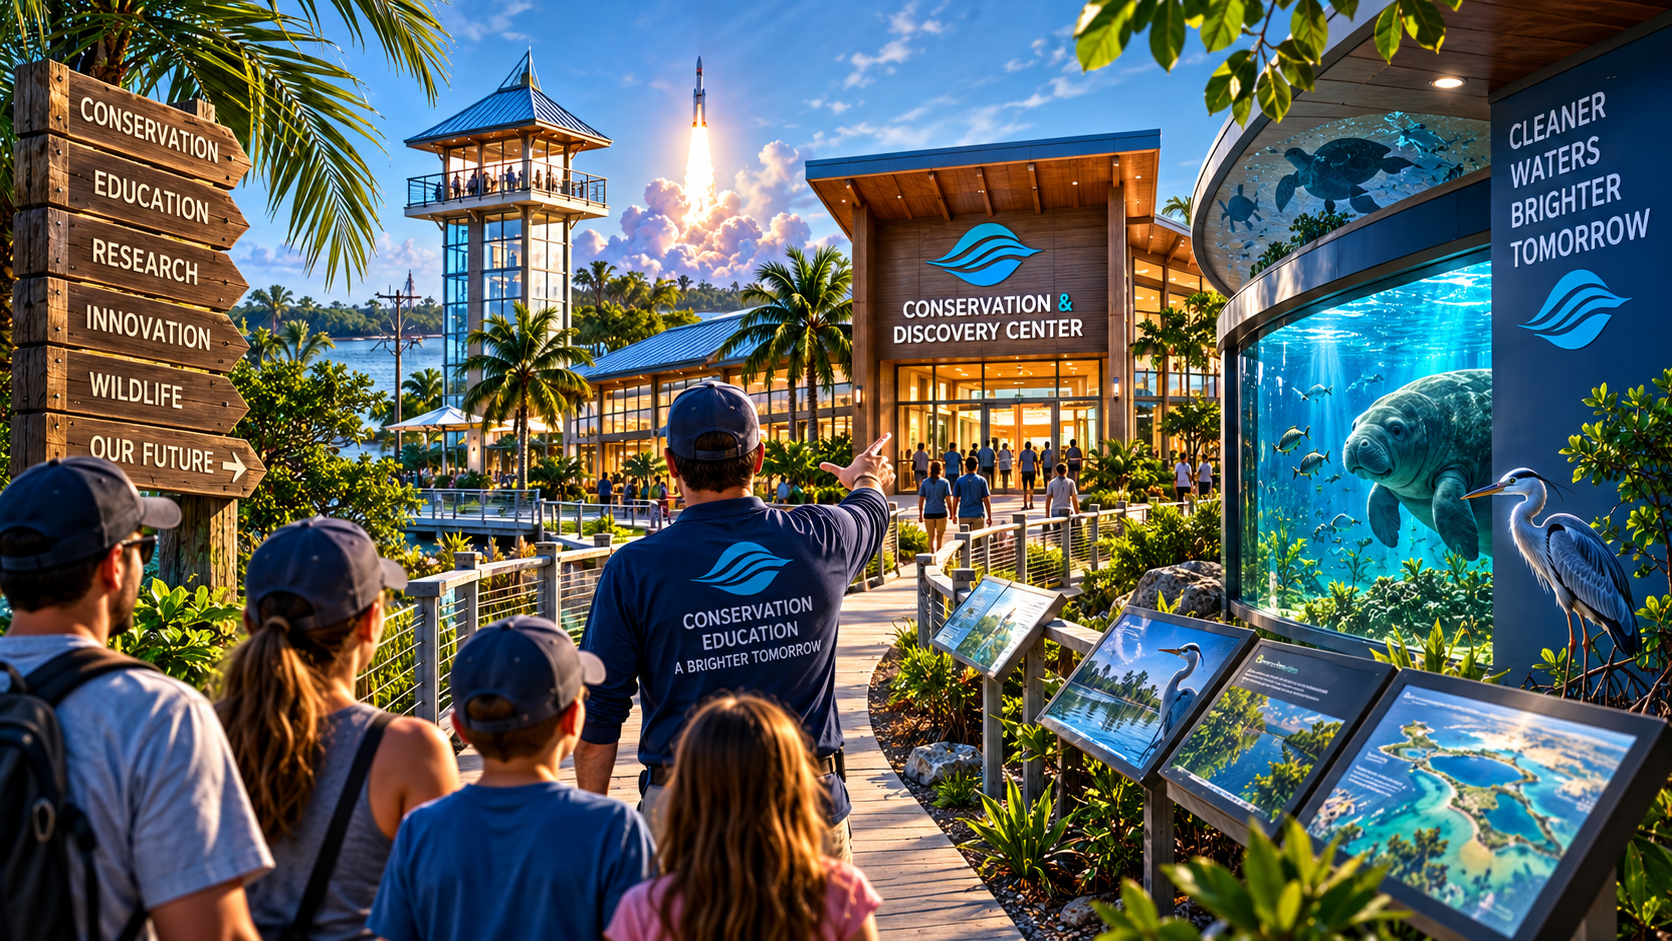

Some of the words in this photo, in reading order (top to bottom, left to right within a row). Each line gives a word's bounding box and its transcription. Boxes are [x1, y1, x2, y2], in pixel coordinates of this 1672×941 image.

[80, 96, 219, 164] CONSERVATION
[1509, 91, 1606, 150] CLEANER
[1510, 135, 1600, 188] WATERS
[94, 169, 209, 224] EDUCATION
[1511, 173, 1621, 229] BRIGHTER
[1510, 208, 1650, 268] TOMORROW
[92, 238, 198, 286] RESEARCH
[85, 304, 211, 351] INNOVATION
[903, 294, 1051, 319] CONSERVATION
[1058, 293, 1073, 312] &
[893, 322, 1001, 344] DISCOVERY
[1006, 319, 1083, 340] CENTER
[88, 371, 183, 409] WILDLIFE
[89, 434, 135, 464] OUR
[142, 442, 214, 474] FUTURE
[682, 596, 813, 630] CONSERVATION
[702, 621, 798, 650] EDUCATION
[674, 662, 684, 674] A
[687, 652, 749, 673] BRIGHTER
[752, 639, 821, 663] TOMORROW
